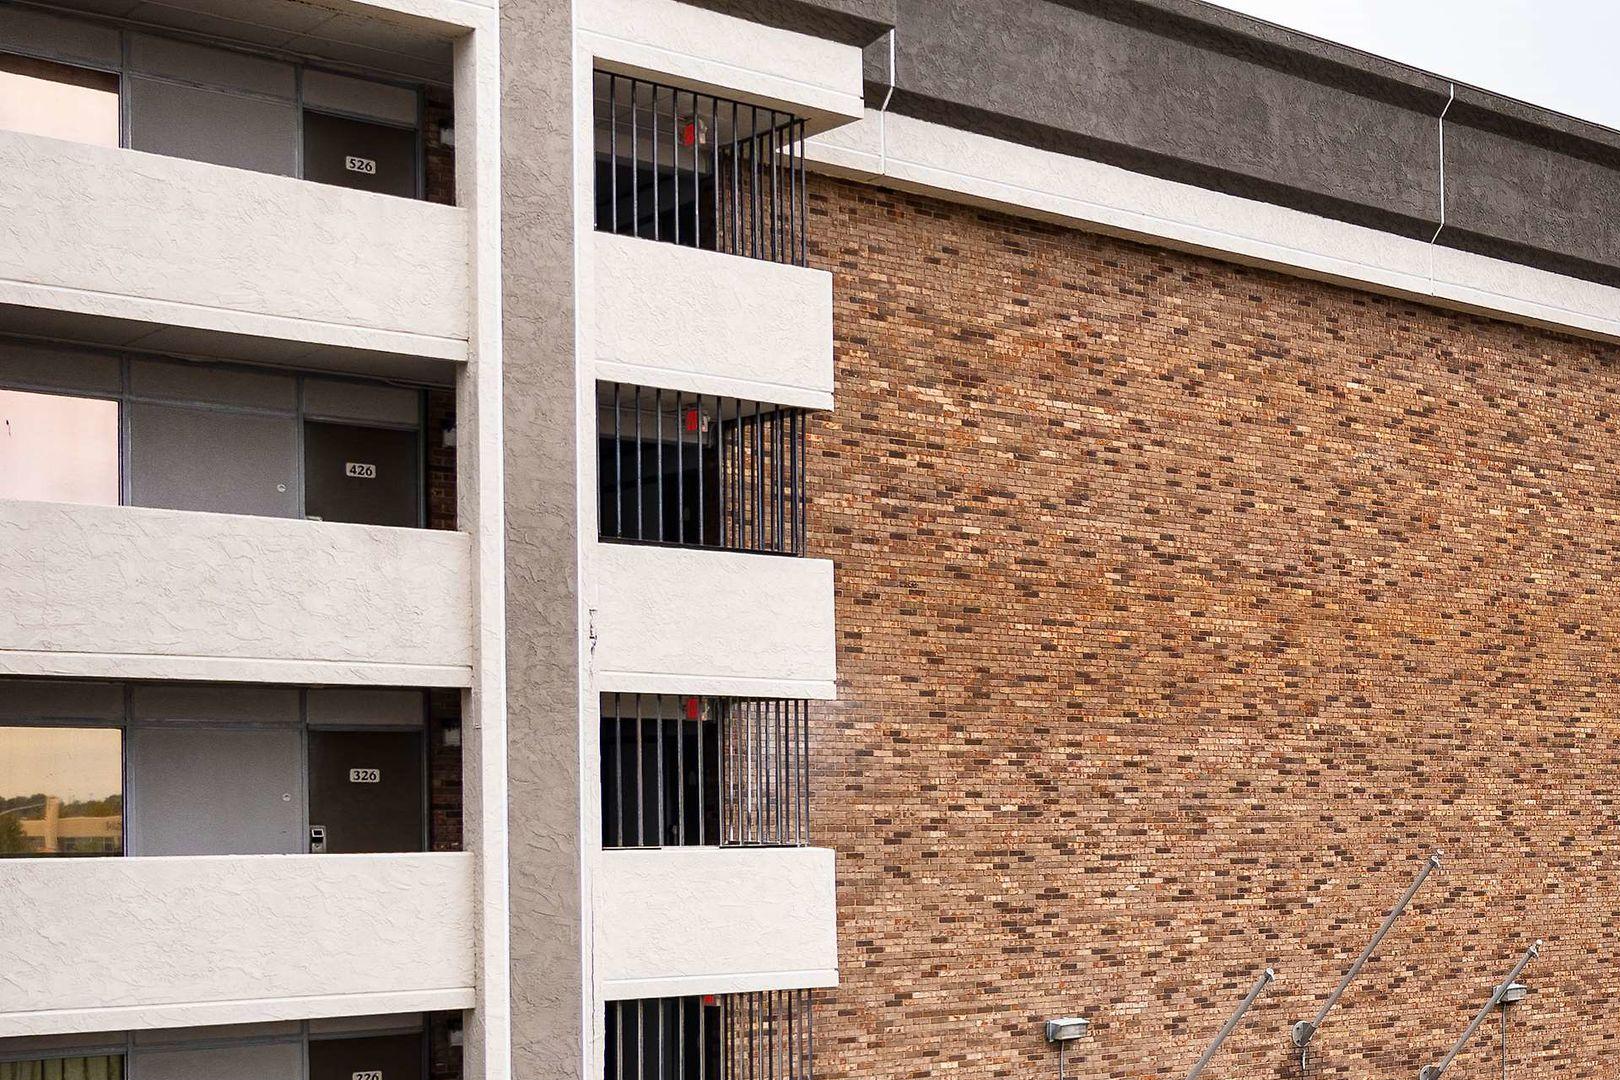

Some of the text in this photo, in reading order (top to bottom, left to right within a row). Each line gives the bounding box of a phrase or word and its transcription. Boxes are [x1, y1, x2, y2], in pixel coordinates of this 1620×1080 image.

[350, 158, 373, 172] 526
[350, 464, 373, 476] 426
[353, 770, 377, 781] 326
